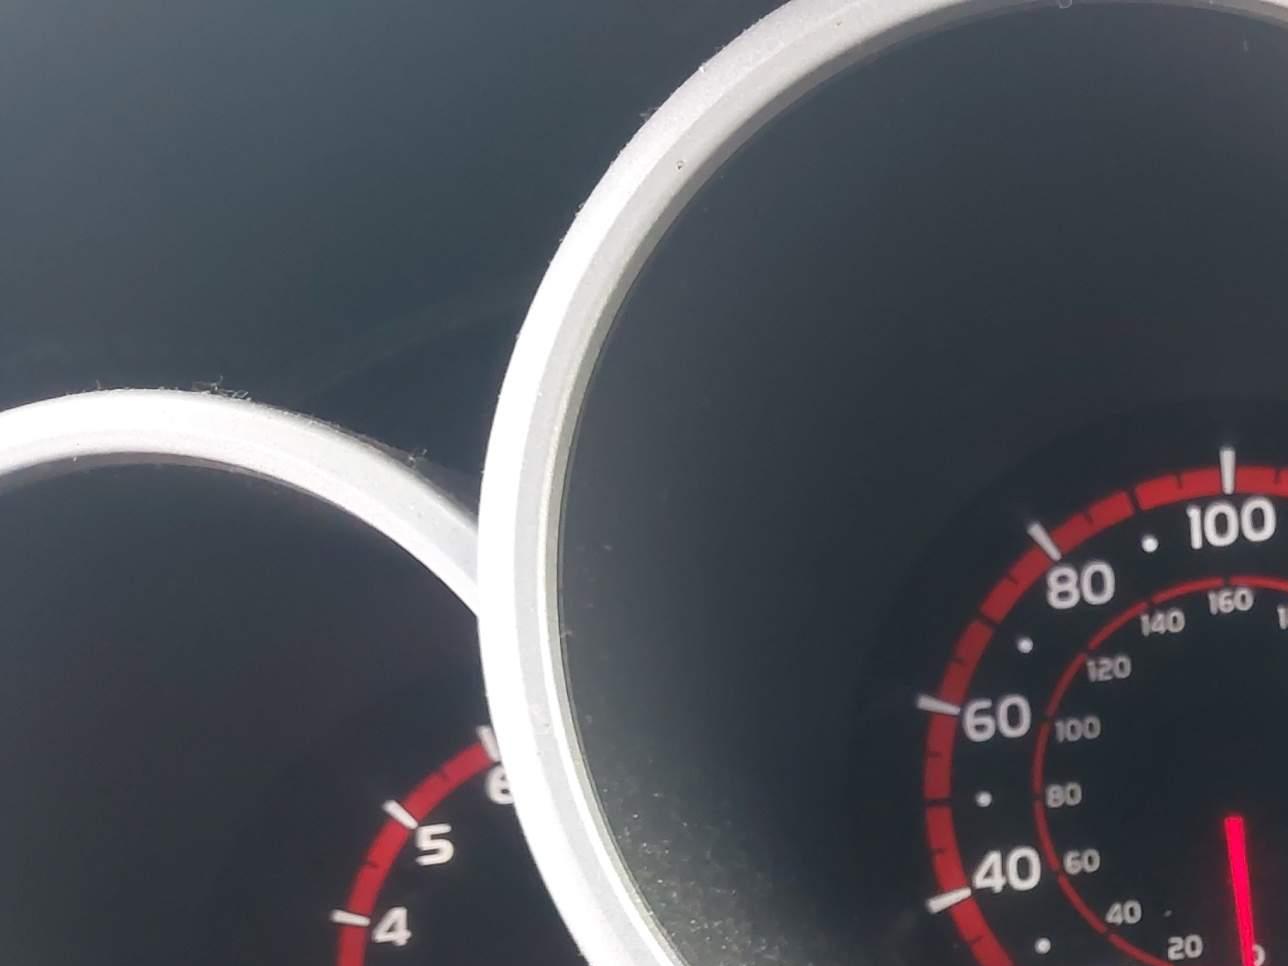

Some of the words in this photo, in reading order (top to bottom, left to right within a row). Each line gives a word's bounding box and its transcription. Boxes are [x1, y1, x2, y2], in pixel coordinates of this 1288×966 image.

[1186, 496, 1277, 549] 100
[1047, 560, 1116, 610] 80
[1208, 586, 1254, 615] 160
[1140, 607, 1185, 636] 140
[1086, 655, 1132, 682] 120
[962, 695, 1031, 743] 60
[1054, 717, 1101, 743] 100
[1045, 784, 1082, 808] 80
[415, 822, 455, 866] 5
[972, 846, 1041, 894] 40
[1062, 849, 1101, 875] 60
[372, 905, 412, 946] 4
[1105, 899, 1142, 925] 40
[1167, 934, 1203, 961] 20
